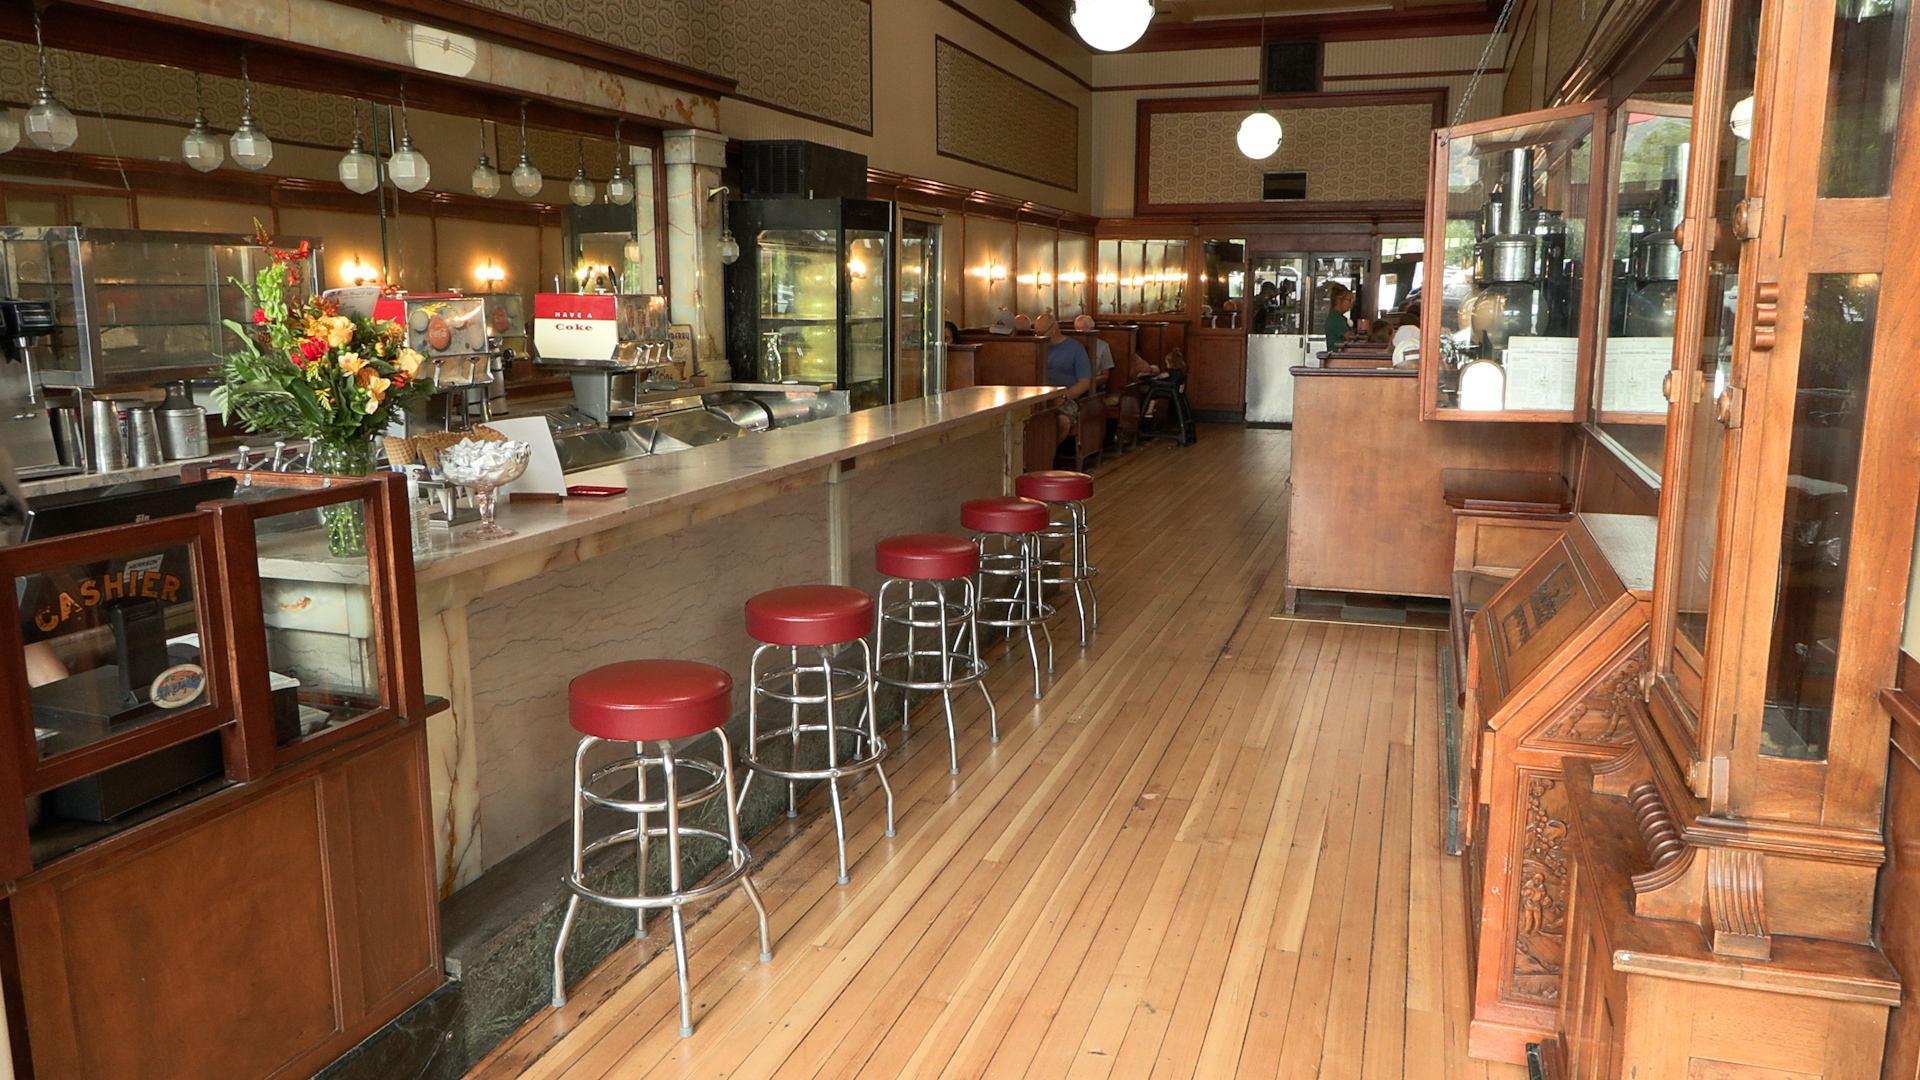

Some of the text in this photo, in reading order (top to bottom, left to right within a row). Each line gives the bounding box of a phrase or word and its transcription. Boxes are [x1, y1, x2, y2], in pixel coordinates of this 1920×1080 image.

[554, 311, 582, 319] HAVE
[555, 323, 593, 331] Coke
[35, 571, 181, 632] CASHIER
